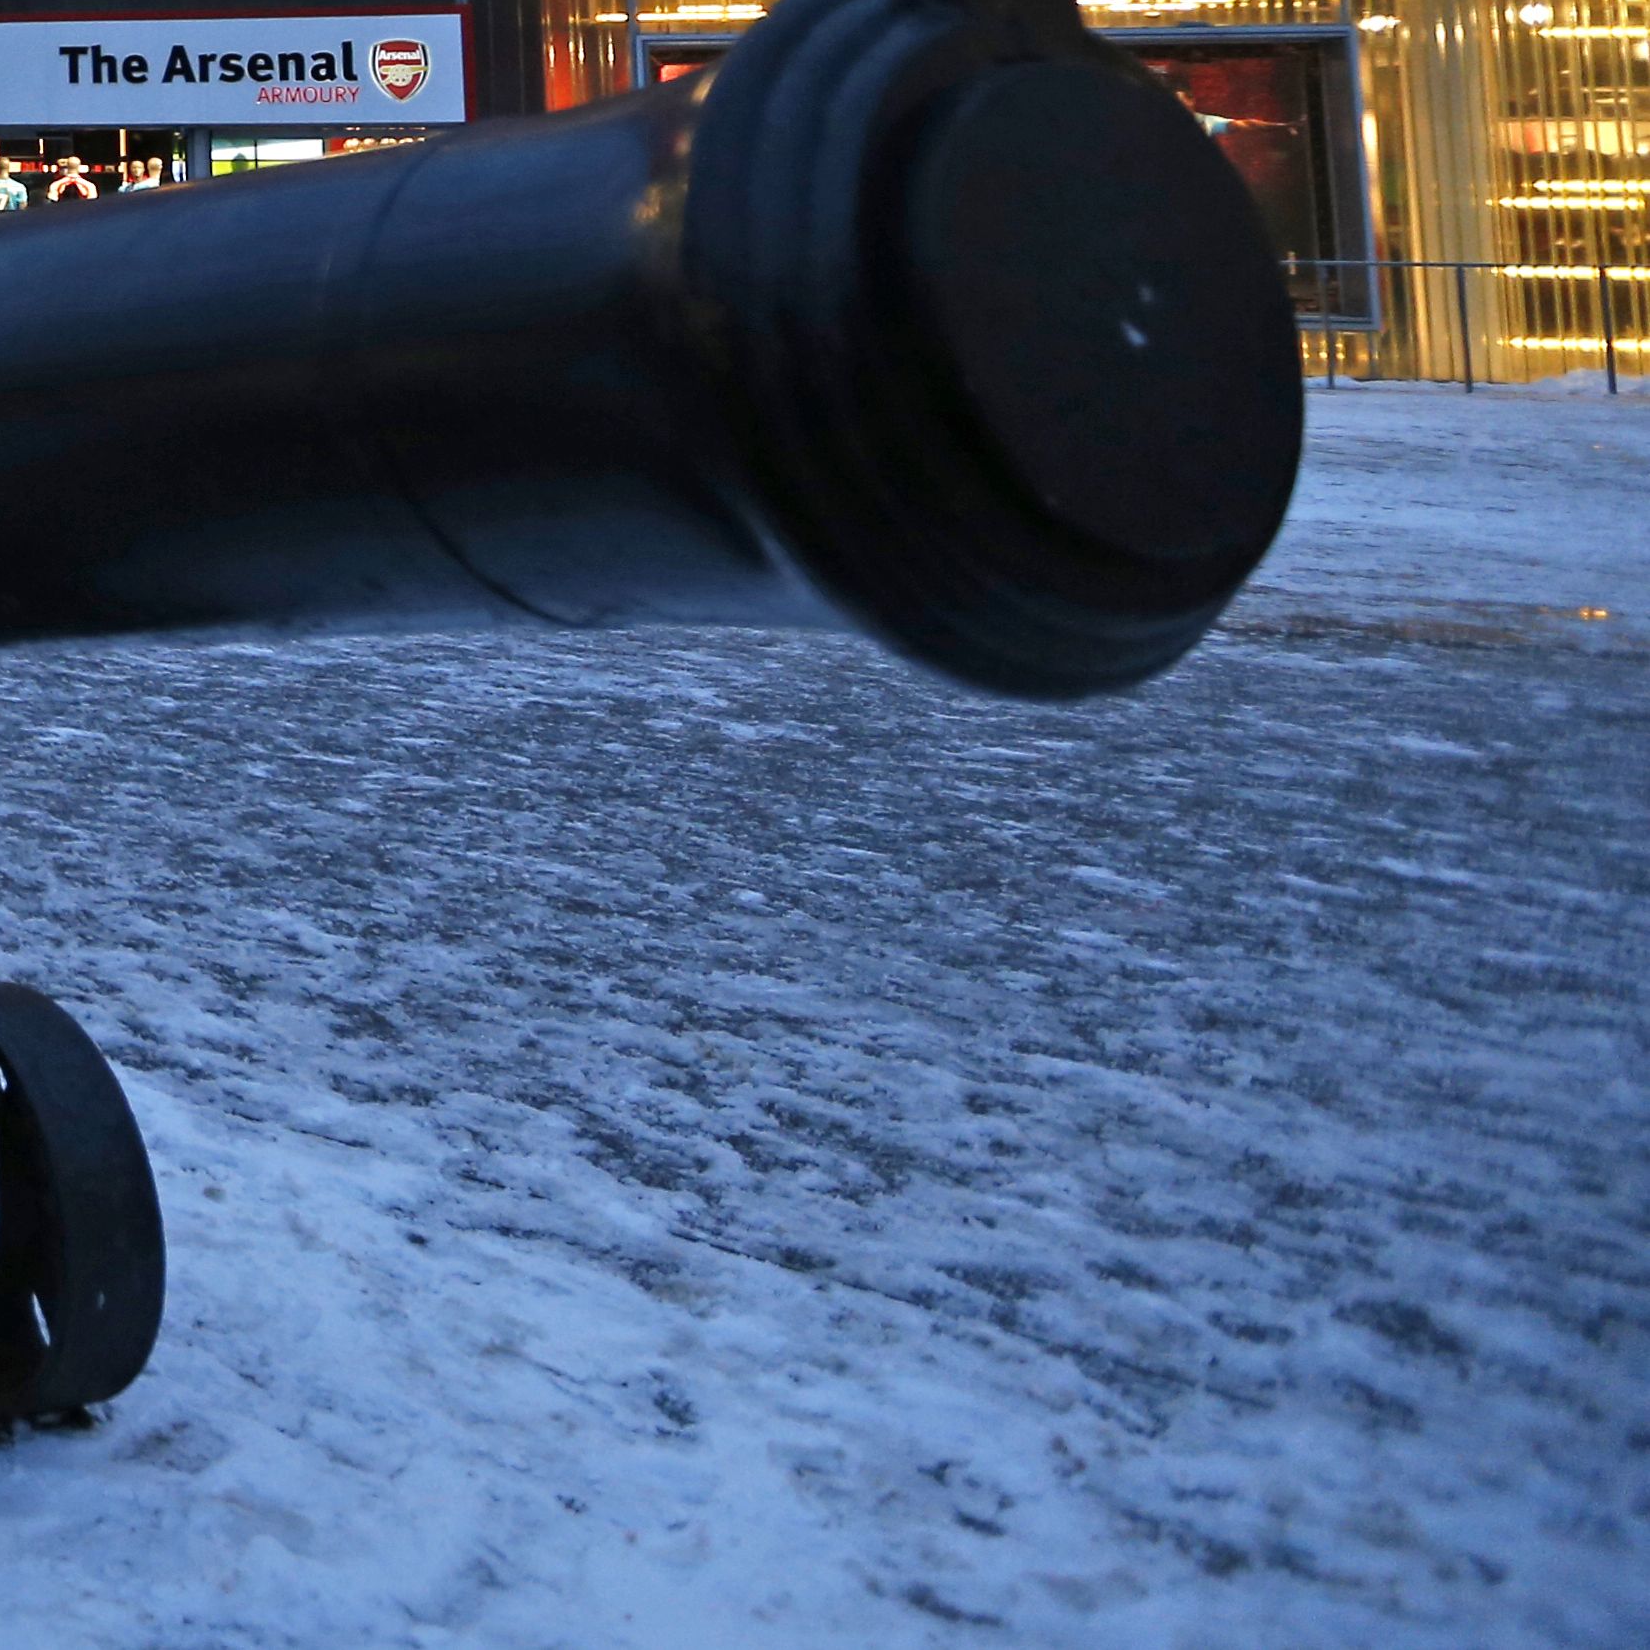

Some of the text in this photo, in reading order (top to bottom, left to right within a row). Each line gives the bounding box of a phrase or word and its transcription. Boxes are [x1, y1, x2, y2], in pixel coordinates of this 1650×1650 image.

[59, 40, 358, 85] The Arsenal
[378, 48, 421, 61] Arsenal
[257, 85, 361, 104] ARMOURY
